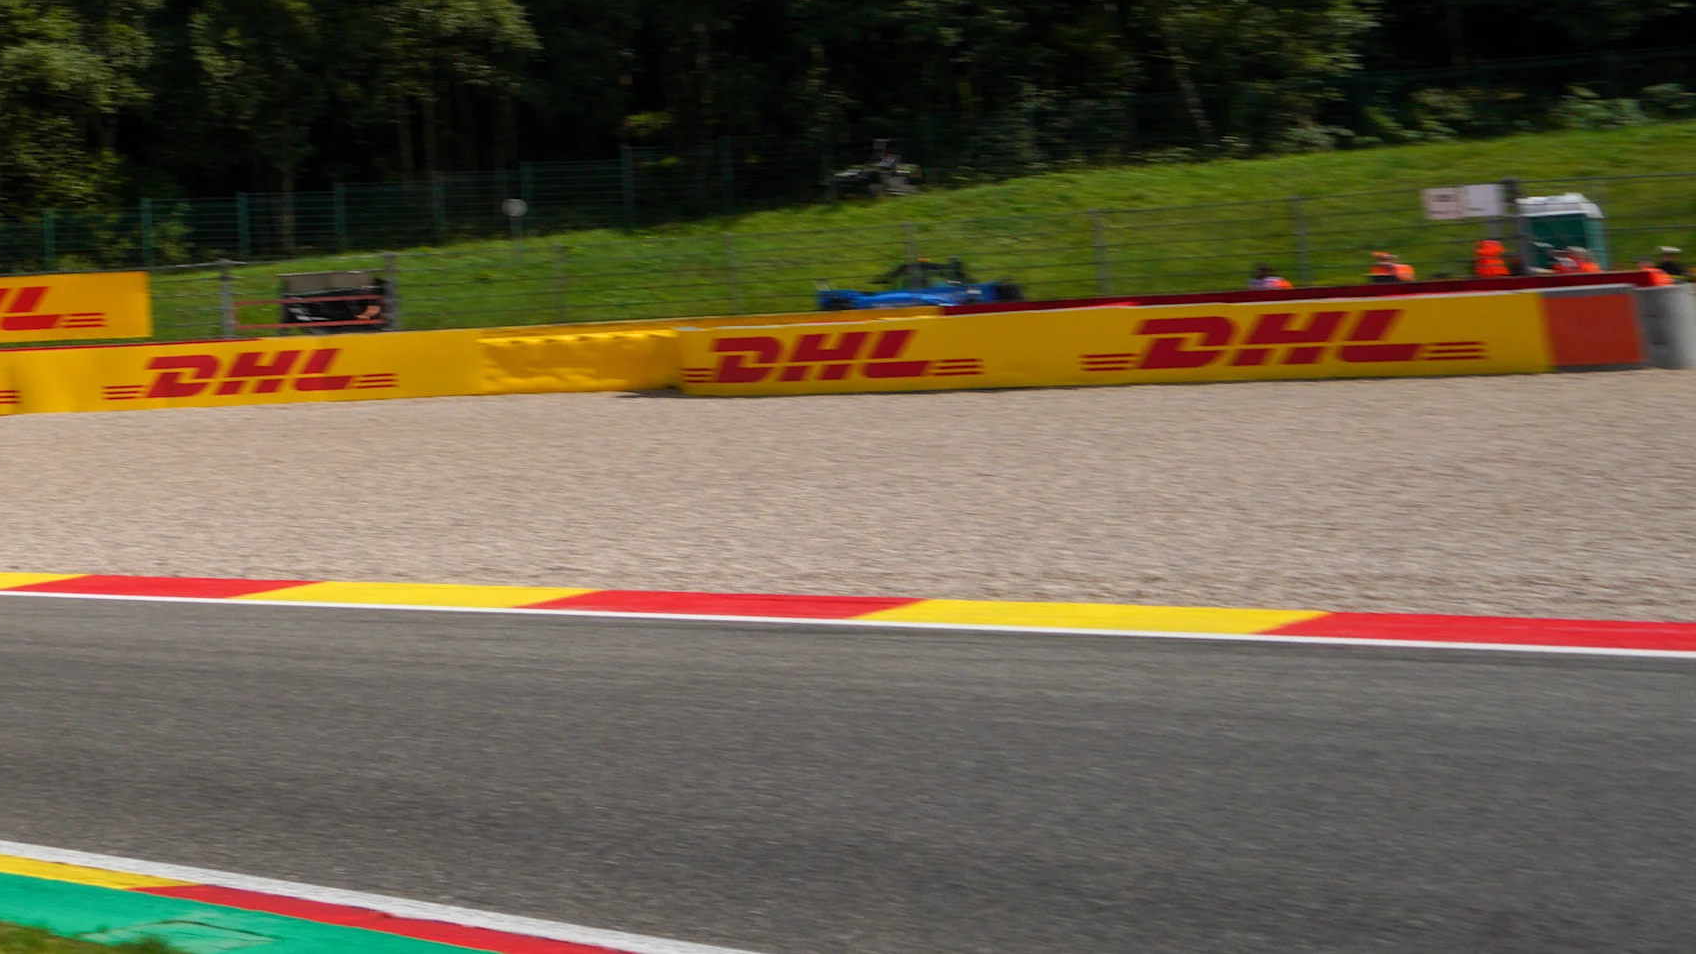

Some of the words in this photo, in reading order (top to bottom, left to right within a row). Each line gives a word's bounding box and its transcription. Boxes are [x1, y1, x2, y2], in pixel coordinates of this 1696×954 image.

[711, 329, 932, 384] DHL
[1134, 309, 1424, 371] DHL
[145, 348, 354, 399] DHL
